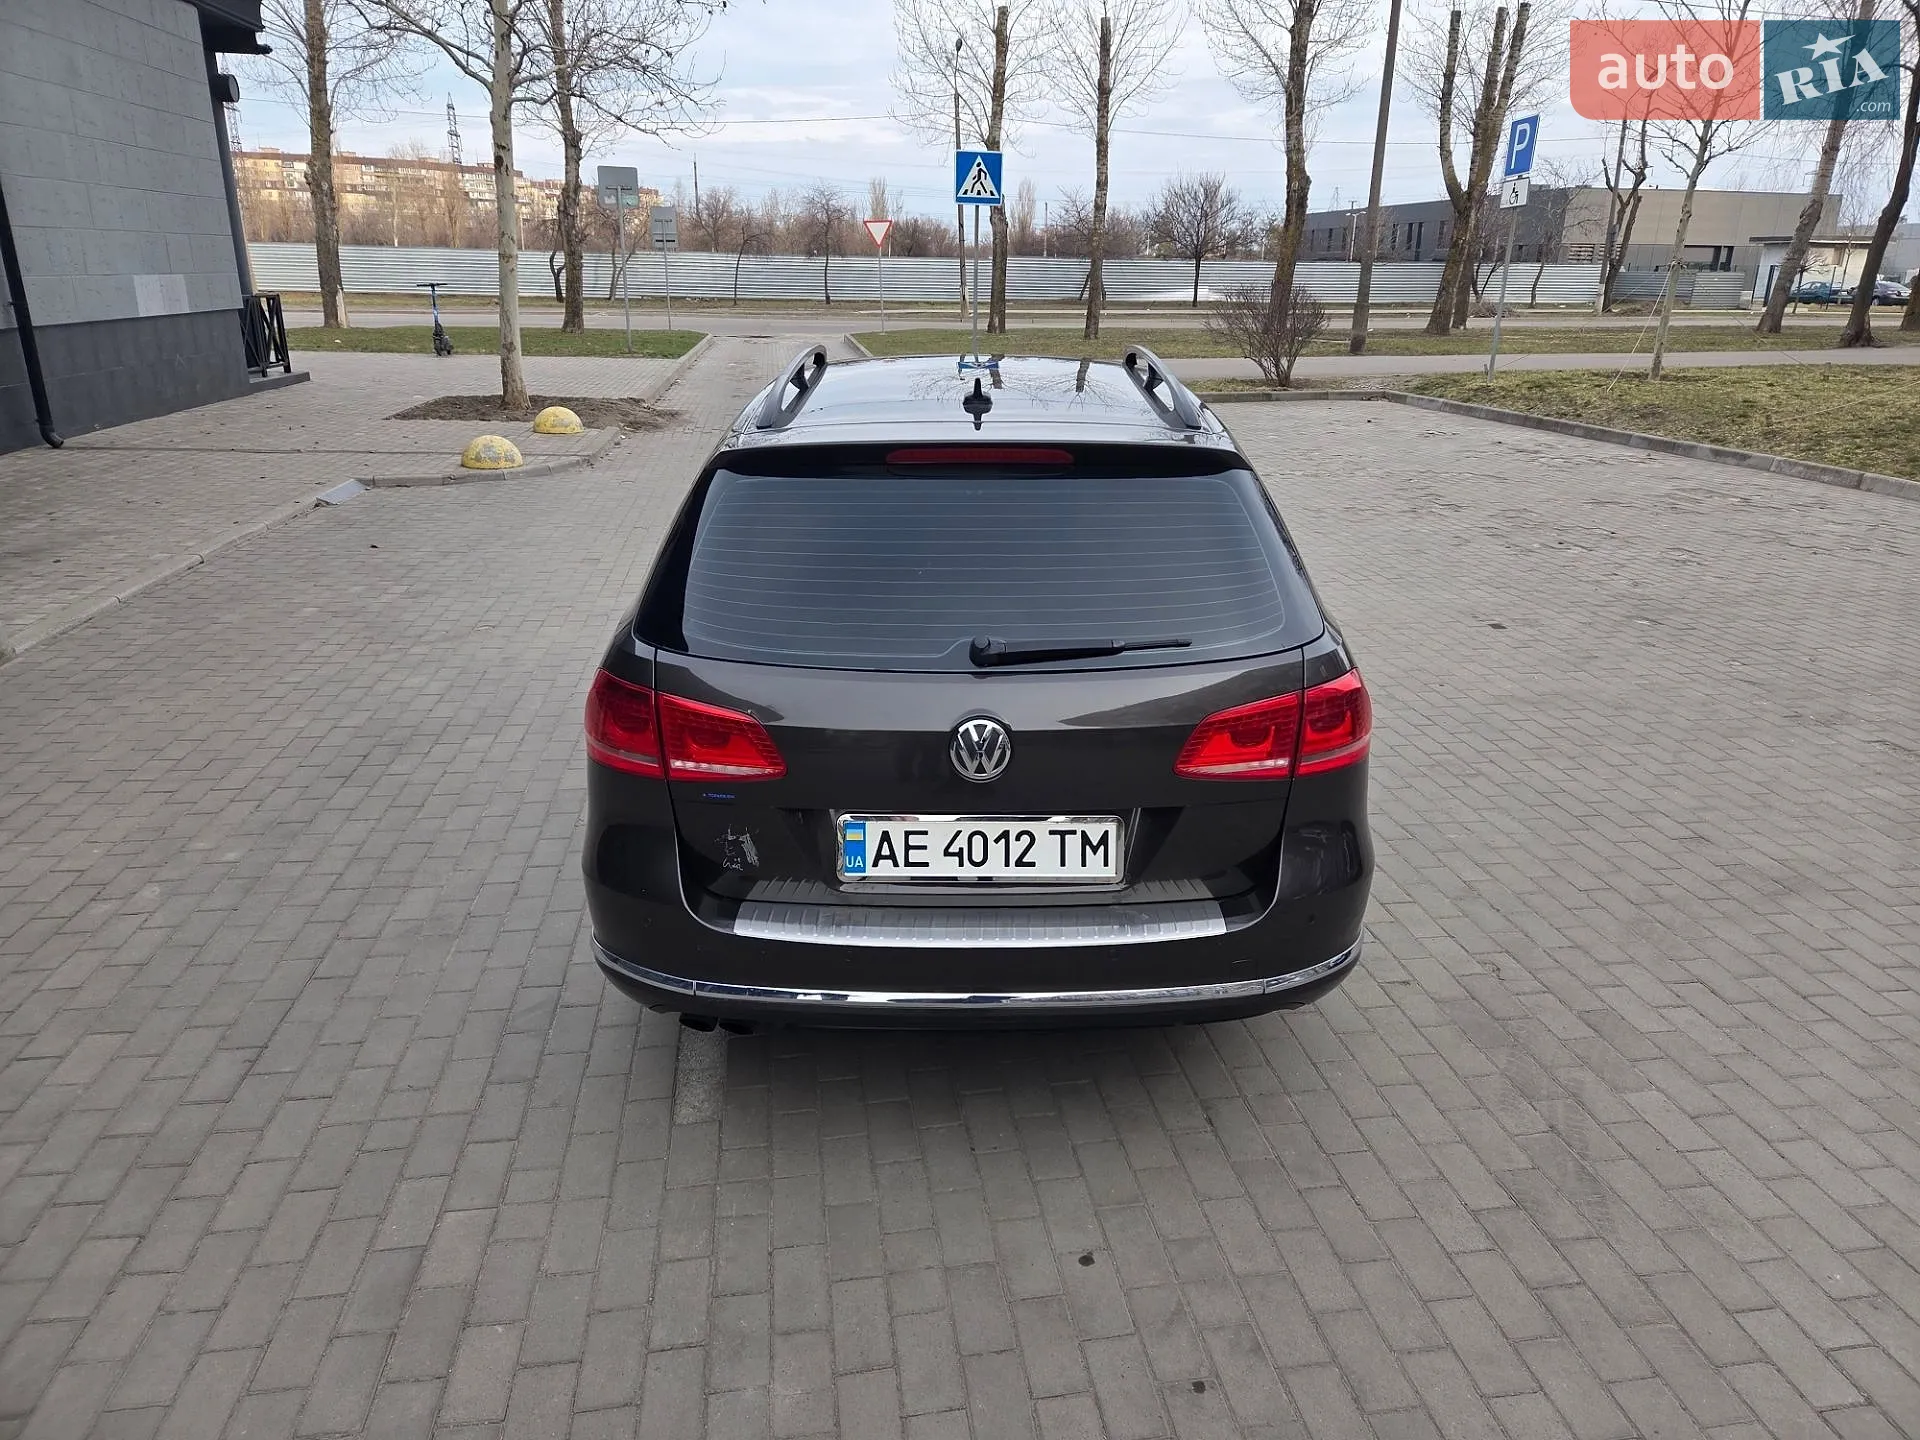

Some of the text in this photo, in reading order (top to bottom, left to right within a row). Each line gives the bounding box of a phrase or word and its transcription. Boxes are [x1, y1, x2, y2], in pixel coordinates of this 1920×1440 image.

[1510, 122, 1531, 169] P
[845, 855, 864, 868] UA
[871, 829, 1110, 868] AE 4012 TM
